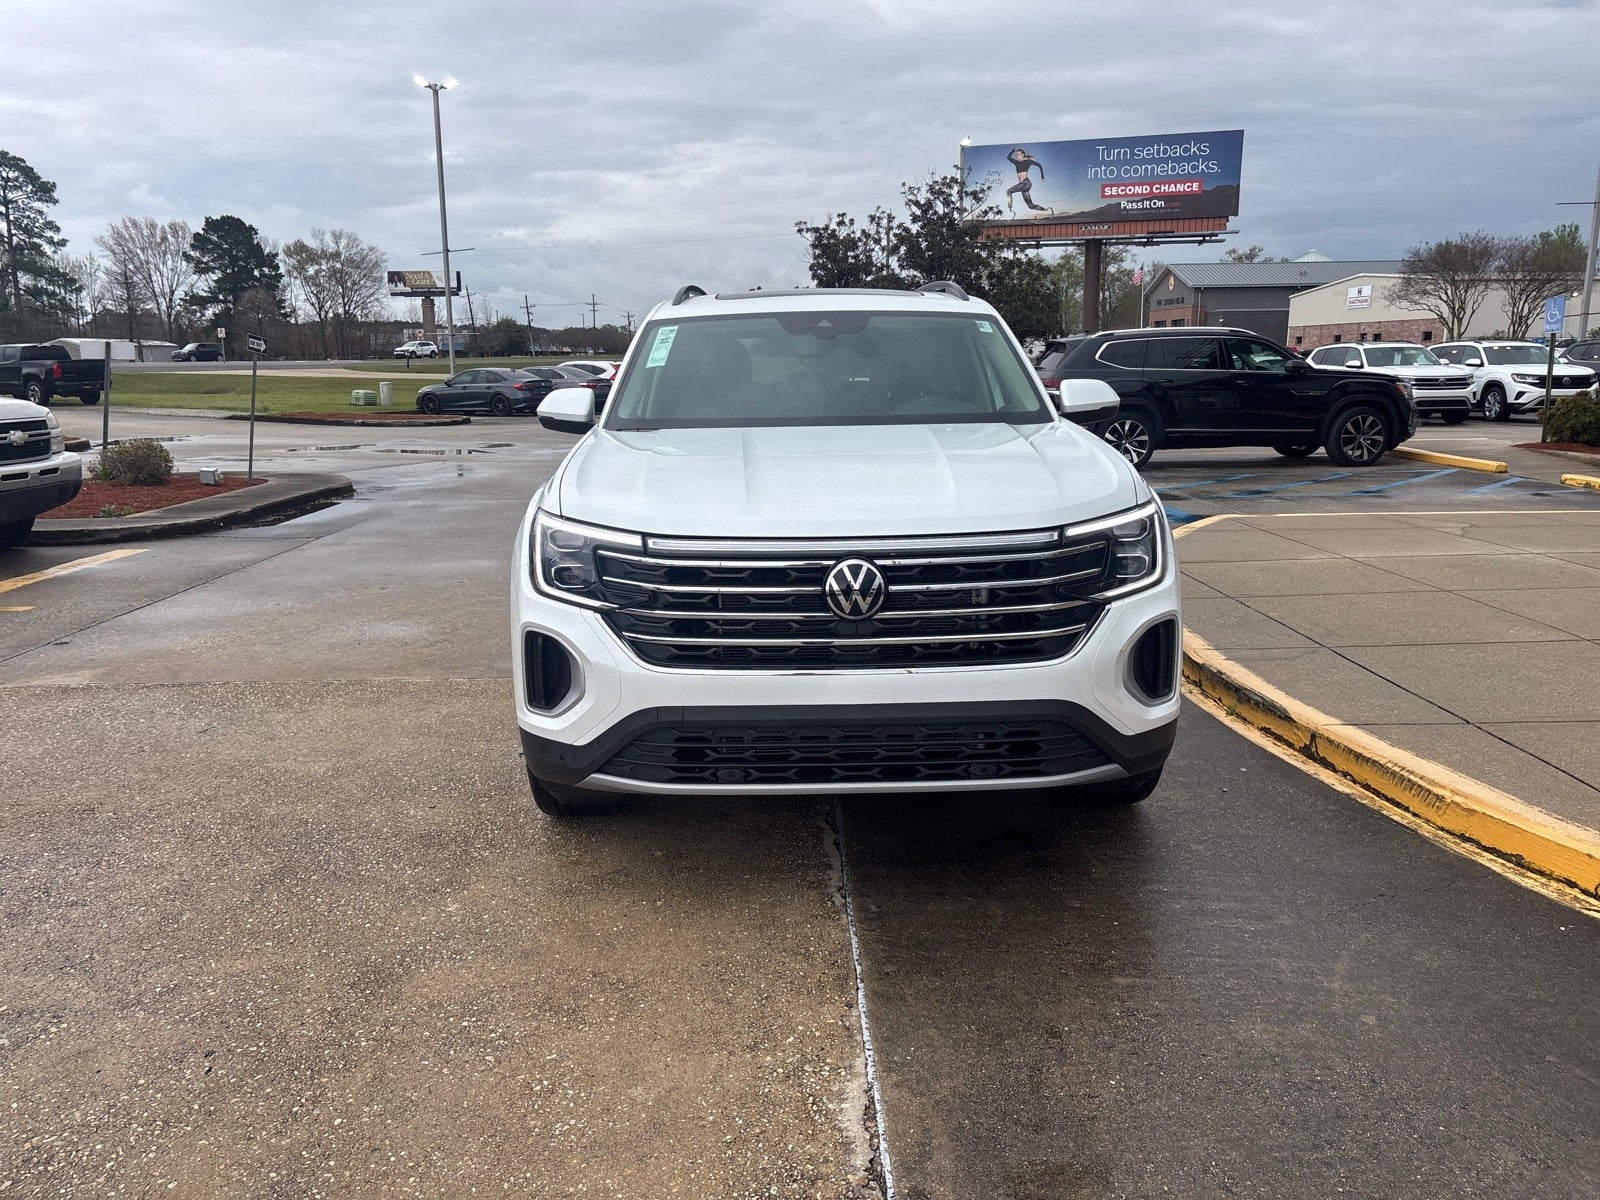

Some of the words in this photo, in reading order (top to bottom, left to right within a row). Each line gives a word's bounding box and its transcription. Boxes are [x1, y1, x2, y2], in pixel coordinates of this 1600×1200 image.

[1096, 146, 1130, 161] Turn
[1133, 140, 1210, 160] setbacks
[1087, 164, 1118, 179] into
[1120, 158, 1221, 178] comebacks.
[1104, 186, 1150, 196] SECOND
[1152, 182, 1200, 194] CHANCE
